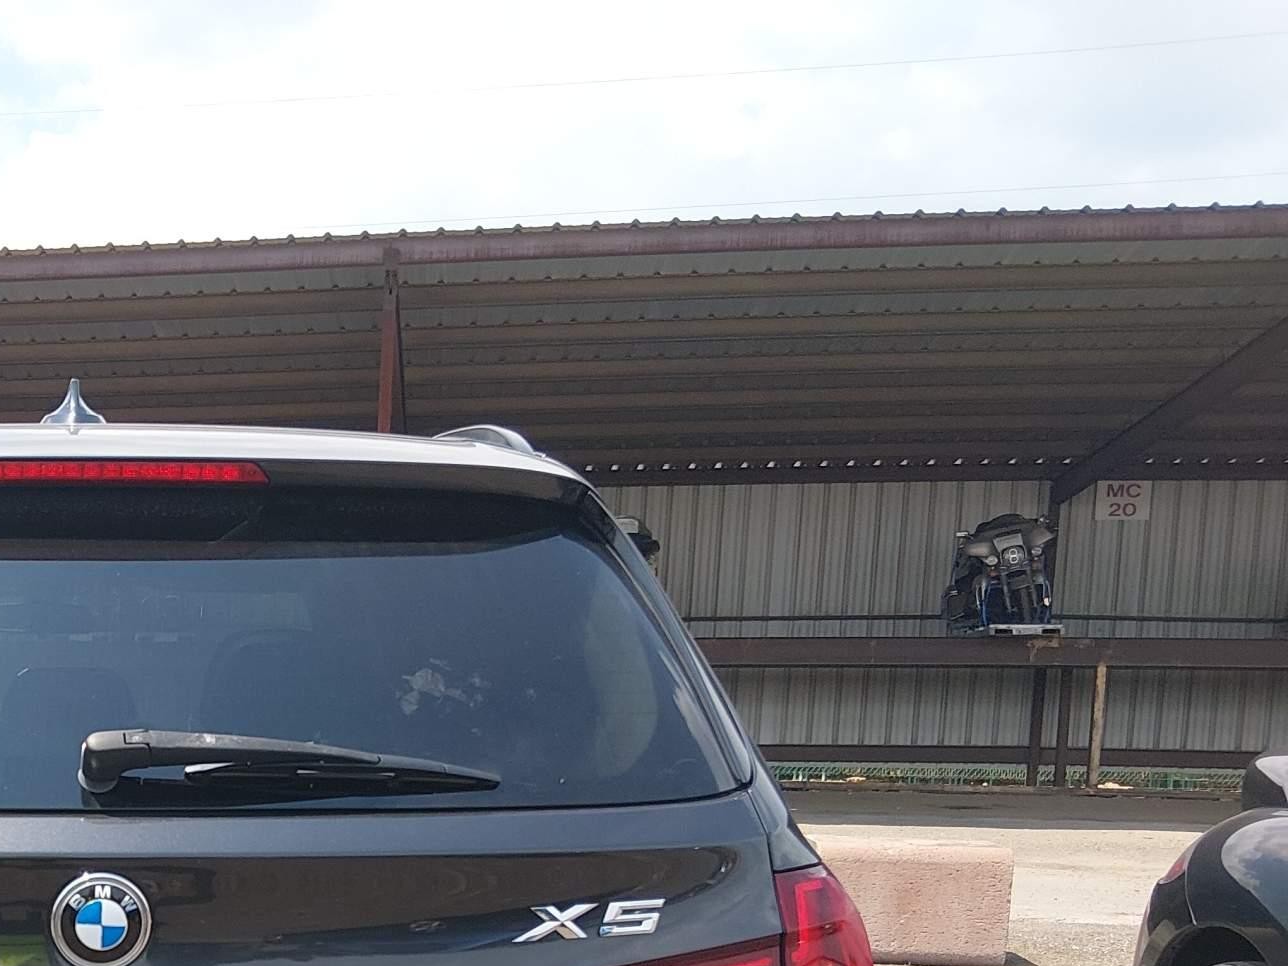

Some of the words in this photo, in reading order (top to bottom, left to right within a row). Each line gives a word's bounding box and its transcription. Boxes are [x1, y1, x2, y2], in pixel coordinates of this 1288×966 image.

[1106, 483, 1142, 498] MC
[1108, 502, 1137, 517] 20
[68, 884, 138, 913] BMW
[511, 898, 667, 943] X5
